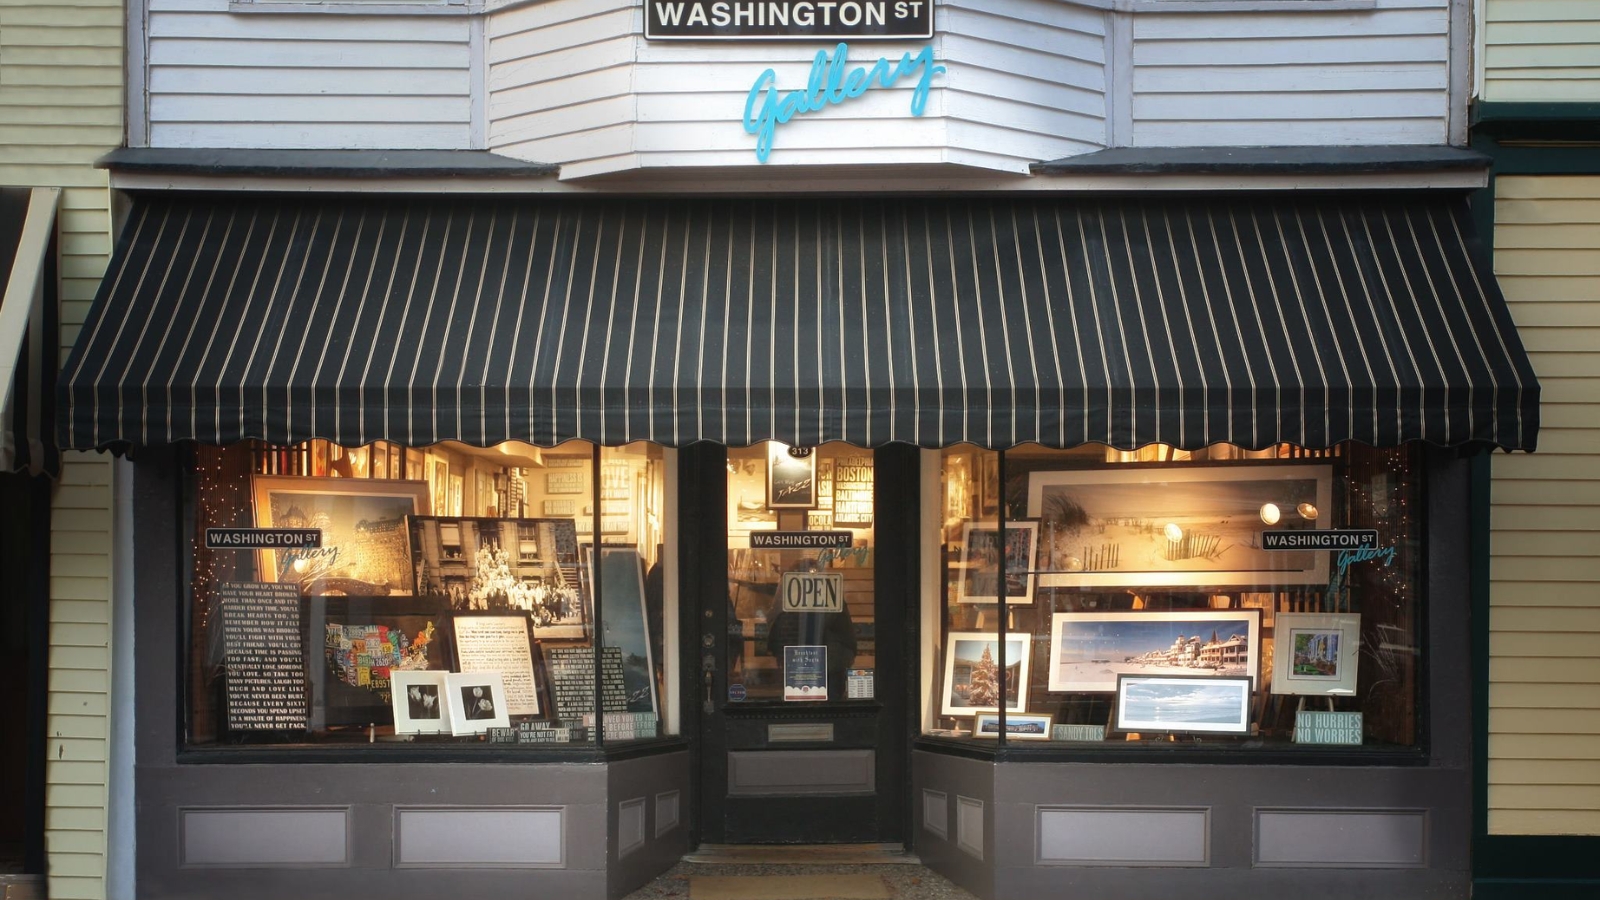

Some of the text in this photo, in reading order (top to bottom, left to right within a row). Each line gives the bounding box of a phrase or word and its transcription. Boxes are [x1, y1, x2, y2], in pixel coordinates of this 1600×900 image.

[657, 2, 923, 26] WASHINGTON ST
[792, 447, 808, 455] 313
[837, 467, 873, 481] BOSTON
[211, 534, 302, 544] WASHINGTON
[754, 536, 836, 545] WASHINGTON
[1267, 535, 1358, 545] WASHINGTON
[788, 577, 837, 607] OPEN
[609, 723, 633, 731] BEFORE
[1298, 714, 1361, 728] NO HURRIES
[1059, 727, 1103, 740] SANDY TOES
[1298, 729, 1361, 743] NO WORRIES
